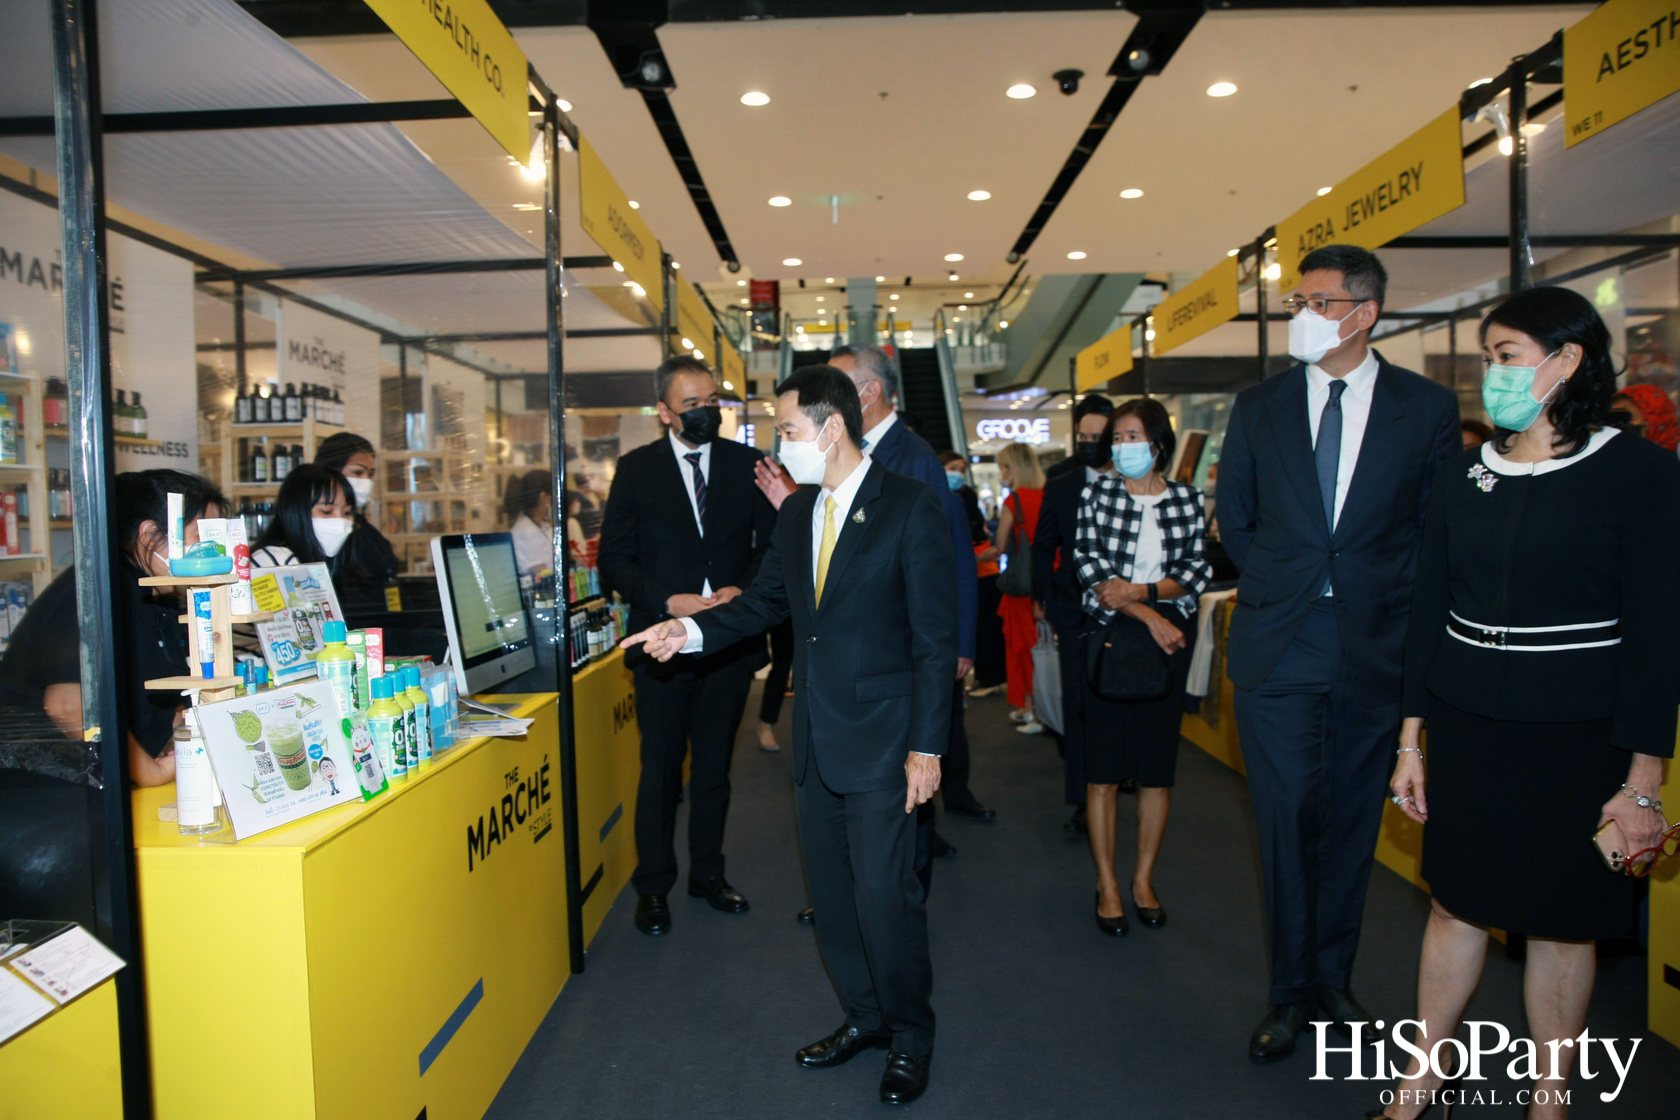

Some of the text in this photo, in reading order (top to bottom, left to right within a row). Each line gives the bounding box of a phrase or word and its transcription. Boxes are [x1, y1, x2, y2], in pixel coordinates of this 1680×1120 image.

[1298, 161, 1424, 257] AZRA JEWELRY
[976, 418, 1050, 439] GROOVE
[504, 766, 519, 789] THE
[467, 754, 551, 873] MARCHÉ
[533, 807, 551, 835] STYLE
